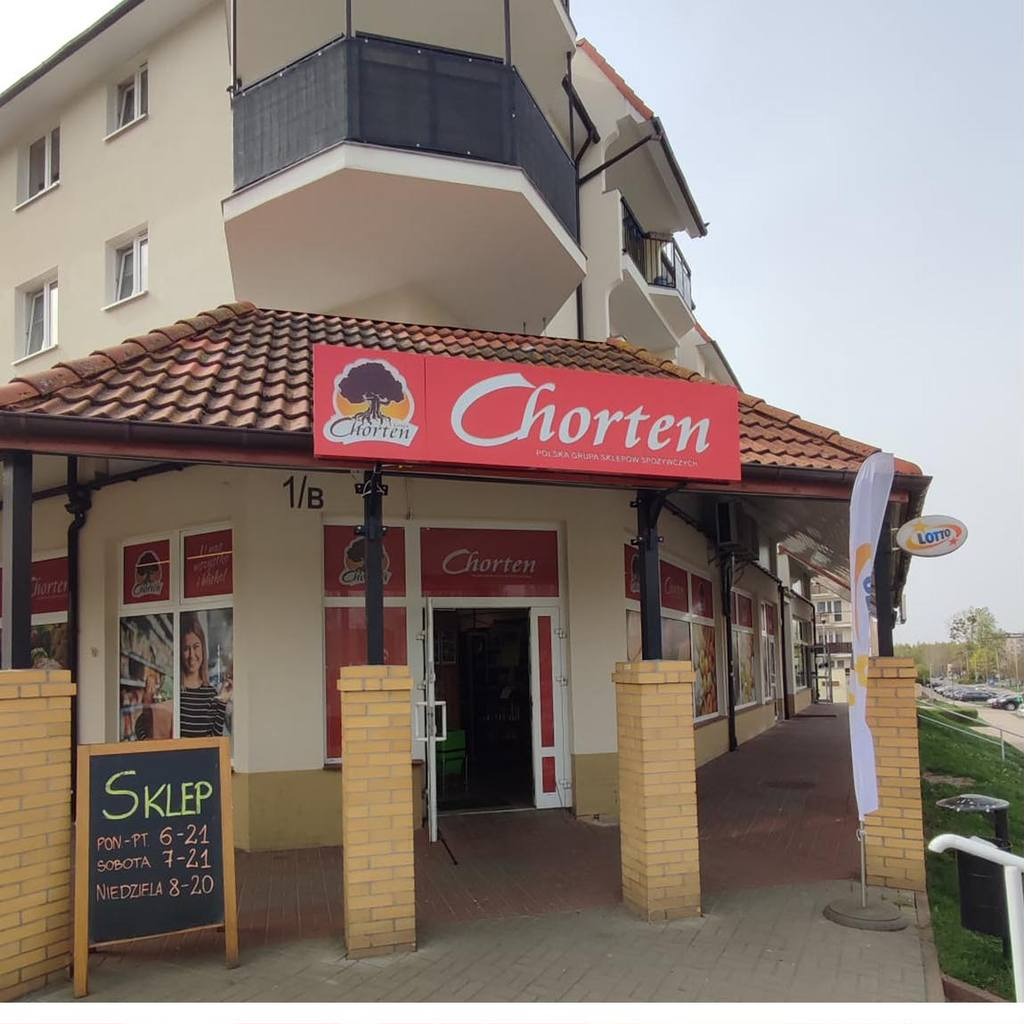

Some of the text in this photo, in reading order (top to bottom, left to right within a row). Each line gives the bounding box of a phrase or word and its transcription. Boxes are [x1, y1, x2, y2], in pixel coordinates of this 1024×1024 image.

[451, 373, 711, 453] Chorten
[330, 417, 409, 439] Chorten
[535, 449, 570, 459] POLSKA
[571, 452, 599, 461] GRUPA
[282, 475, 324, 510] 1/B
[917, 528, 951, 545] LOTTO
[442, 549, 536, 575] Chorten
[31, 577, 68, 598] horten
[102, 770, 213, 820] SKLEP
[159, 824, 210, 846] 6-21
[97, 848, 212, 873] SOBOTA 7-21
[97, 875, 214, 901] NIEDZIELA 8-20
